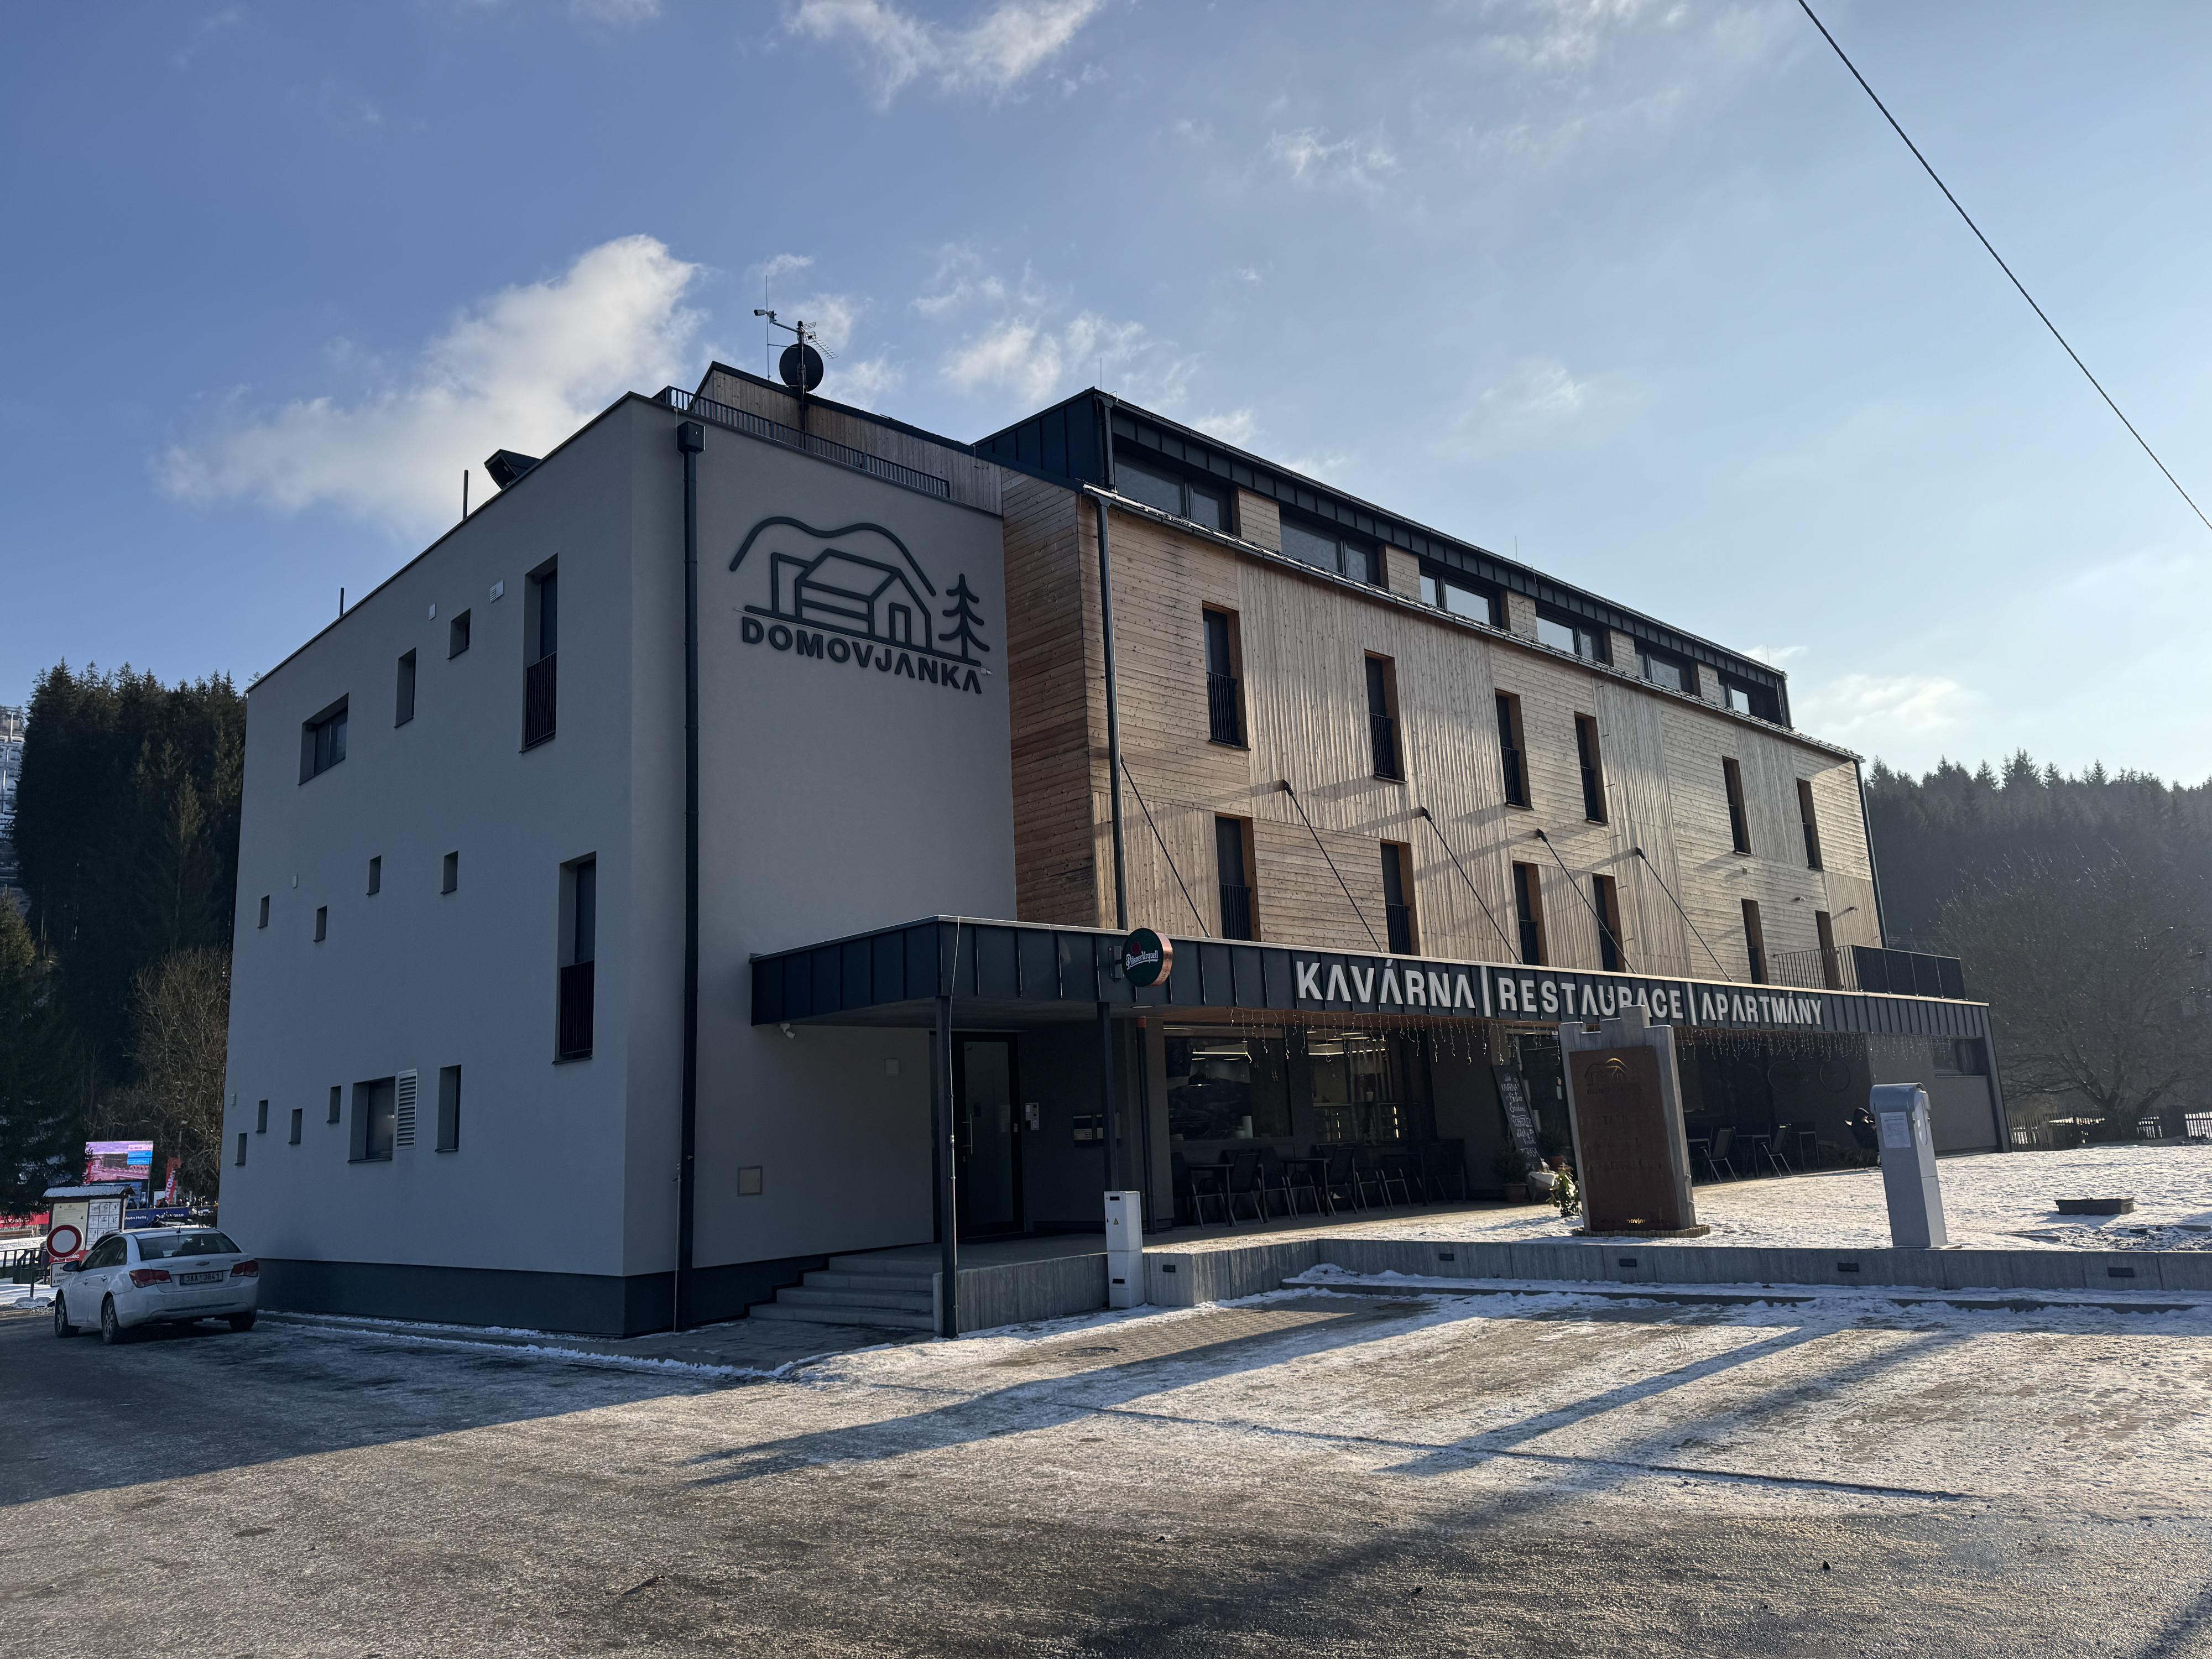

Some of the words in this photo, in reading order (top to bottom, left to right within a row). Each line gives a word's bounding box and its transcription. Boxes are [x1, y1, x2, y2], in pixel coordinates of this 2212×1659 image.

[742, 617, 983, 695] DOMOVJANKA
[1126, 953, 1142, 970] Pilsner
[1141, 950, 1159, 963] Urquell
[1295, 959, 1475, 1009] KAVÁRNA
[1497, 977, 1684, 1019] RESTAURACE
[1702, 991, 1822, 1025] APARTMÁNY
